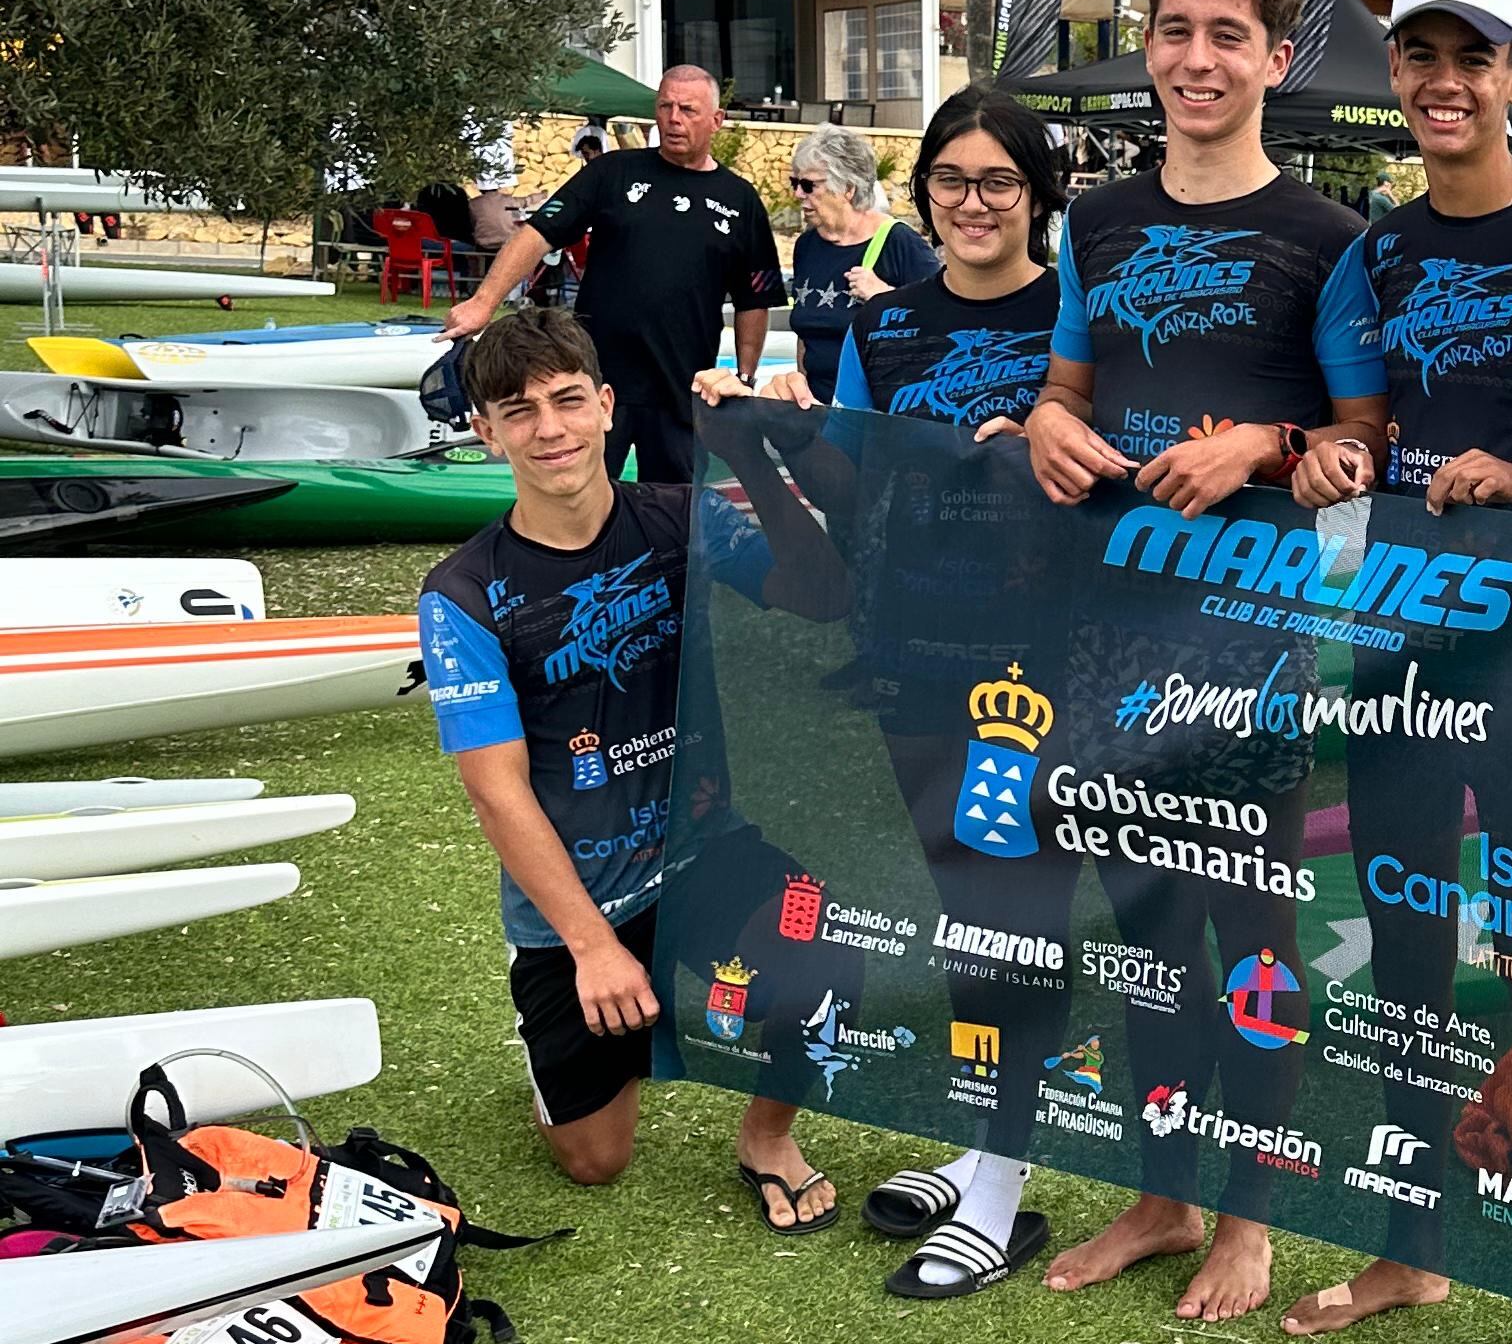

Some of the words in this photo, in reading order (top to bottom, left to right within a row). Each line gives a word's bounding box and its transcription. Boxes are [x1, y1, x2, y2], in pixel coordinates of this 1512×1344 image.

[1086, 260, 1256, 323] MARLINES
[1154, 302, 1258, 345] LANZAROTE
[888, 352, 1050, 417] MARLINES
[966, 386, 1043, 426] LANZARO
[1123, 406, 1182, 434] Islas
[542, 575, 673, 686] MARLINES
[1200, 594, 1254, 624] CLUB
[1255, 607, 1287, 630] DE
[616, 611, 684, 673] LANZARO
[1113, 651, 1494, 745] #somoslosmarlines
[607, 725, 677, 760] Gobiern
[612, 755, 635, 776] de
[629, 799, 671, 828] Isla
[1047, 764, 1269, 837] Gobierno
[1054, 814, 1111, 857] de
[1116, 823, 1317, 903] Canarias
[820, 922, 907, 957] Lanzarote
[825, 902, 892, 932] Cabildo
[894, 917, 918, 938] de
[932, 913, 1065, 971] Lanzarote
[1082, 939, 1154, 962] european
[927, 955, 936, 968] A
[942, 958, 998, 981] UNIQUE
[1005, 971, 1066, 991] ISLAND
[1107, 978, 1176, 1006] DESTINATION
[1325, 979, 1407, 1021] Centros
[1413, 1005, 1440, 1030] de
[1445, 1013, 1496, 1051] Arte,
[837, 1022, 897, 1052] Arrecife
[1324, 1007, 1400, 1048] Cultura
[1401, 1033, 1415, 1056] y
[1416, 1030, 1496, 1076] Turismo
[949, 1076, 998, 1096] TURISMO
[1322, 1044, 1381, 1076] Cabildo
[1384, 1062, 1404, 1082] de
[1407, 1067, 1484, 1105] Lanzarote
[946, 1089, 999, 1111] ARRECIFE
[1256, 1152, 1320, 1179] eventos
[359, 1181, 417, 1227] 45
[1343, 1166, 1442, 1210] MARCET
